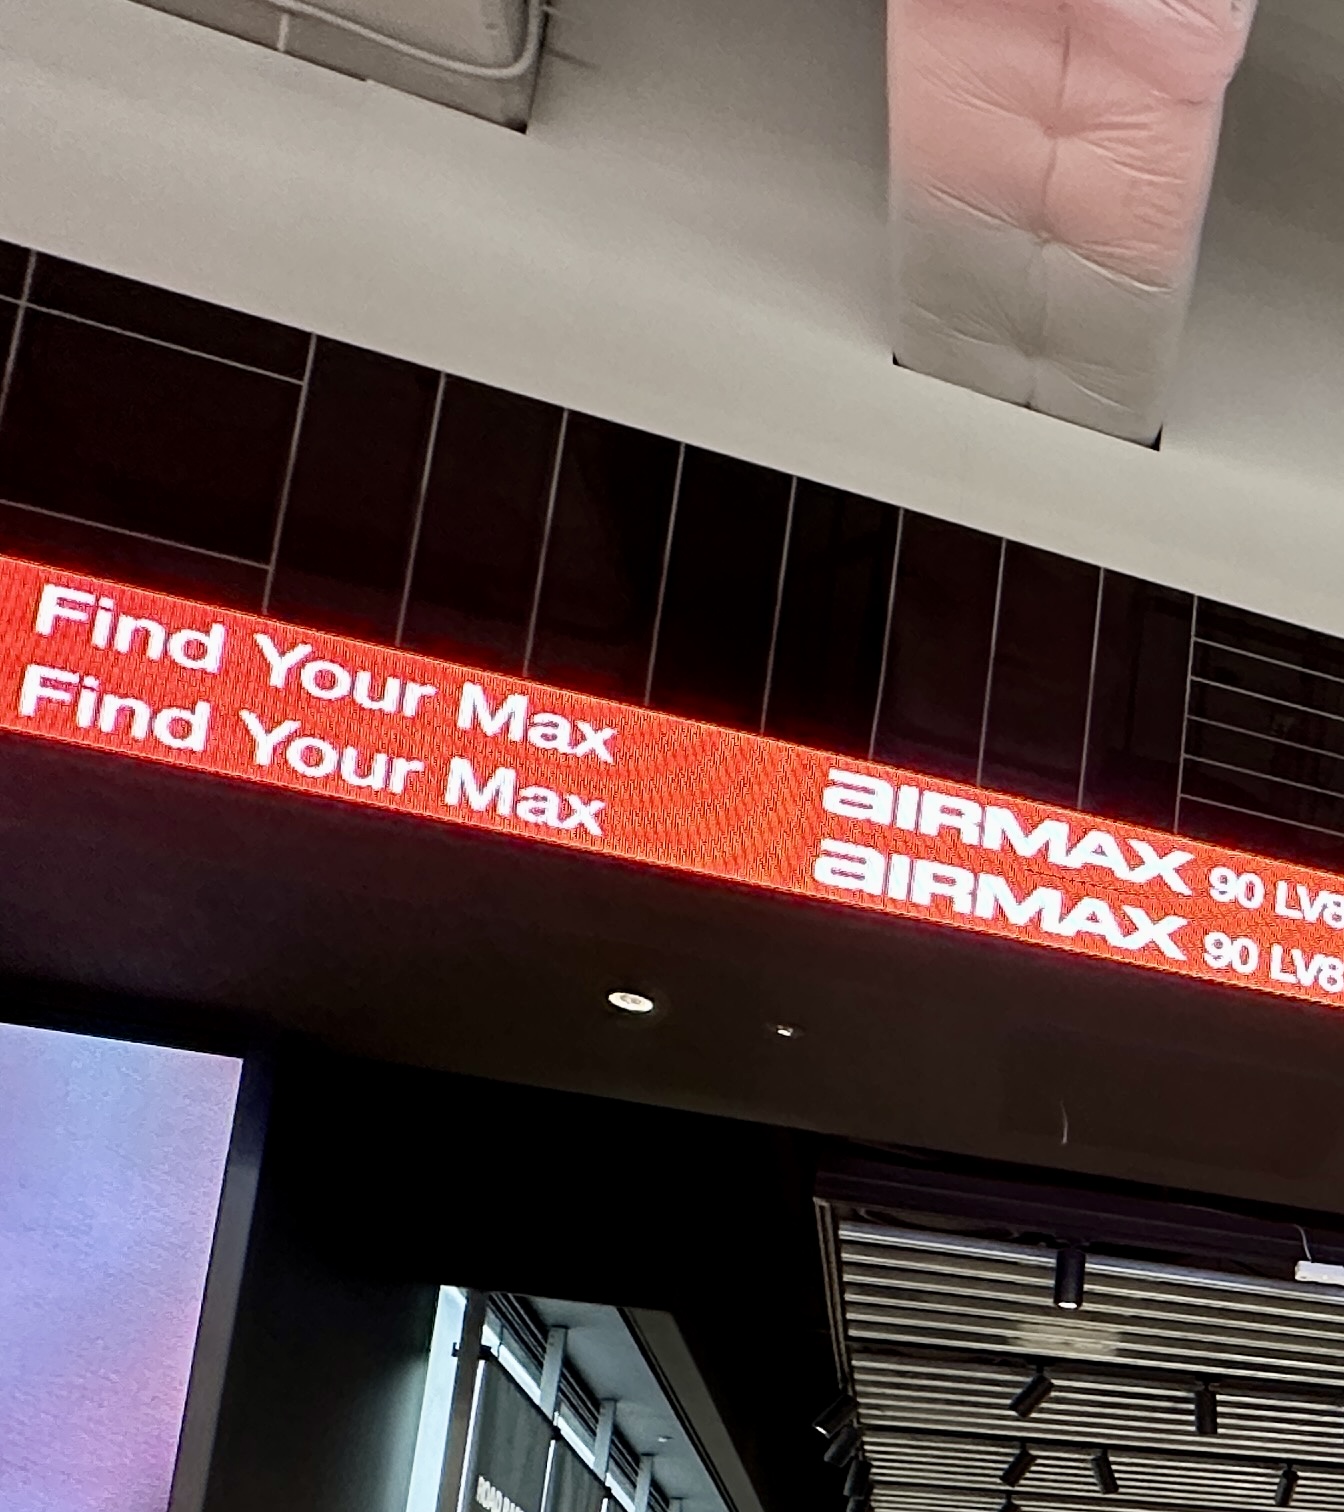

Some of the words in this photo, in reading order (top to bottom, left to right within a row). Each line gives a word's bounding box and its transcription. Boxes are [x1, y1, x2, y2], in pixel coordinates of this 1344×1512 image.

[35, 583, 226, 674] Find
[252, 632, 438, 718] Your
[456, 681, 618, 766] Max
[18, 663, 211, 753] Find
[238, 708, 425, 795] Your
[444, 755, 606, 838] Max
[1208, 865, 1266, 911] 90
[1201, 929, 1261, 976] 90
